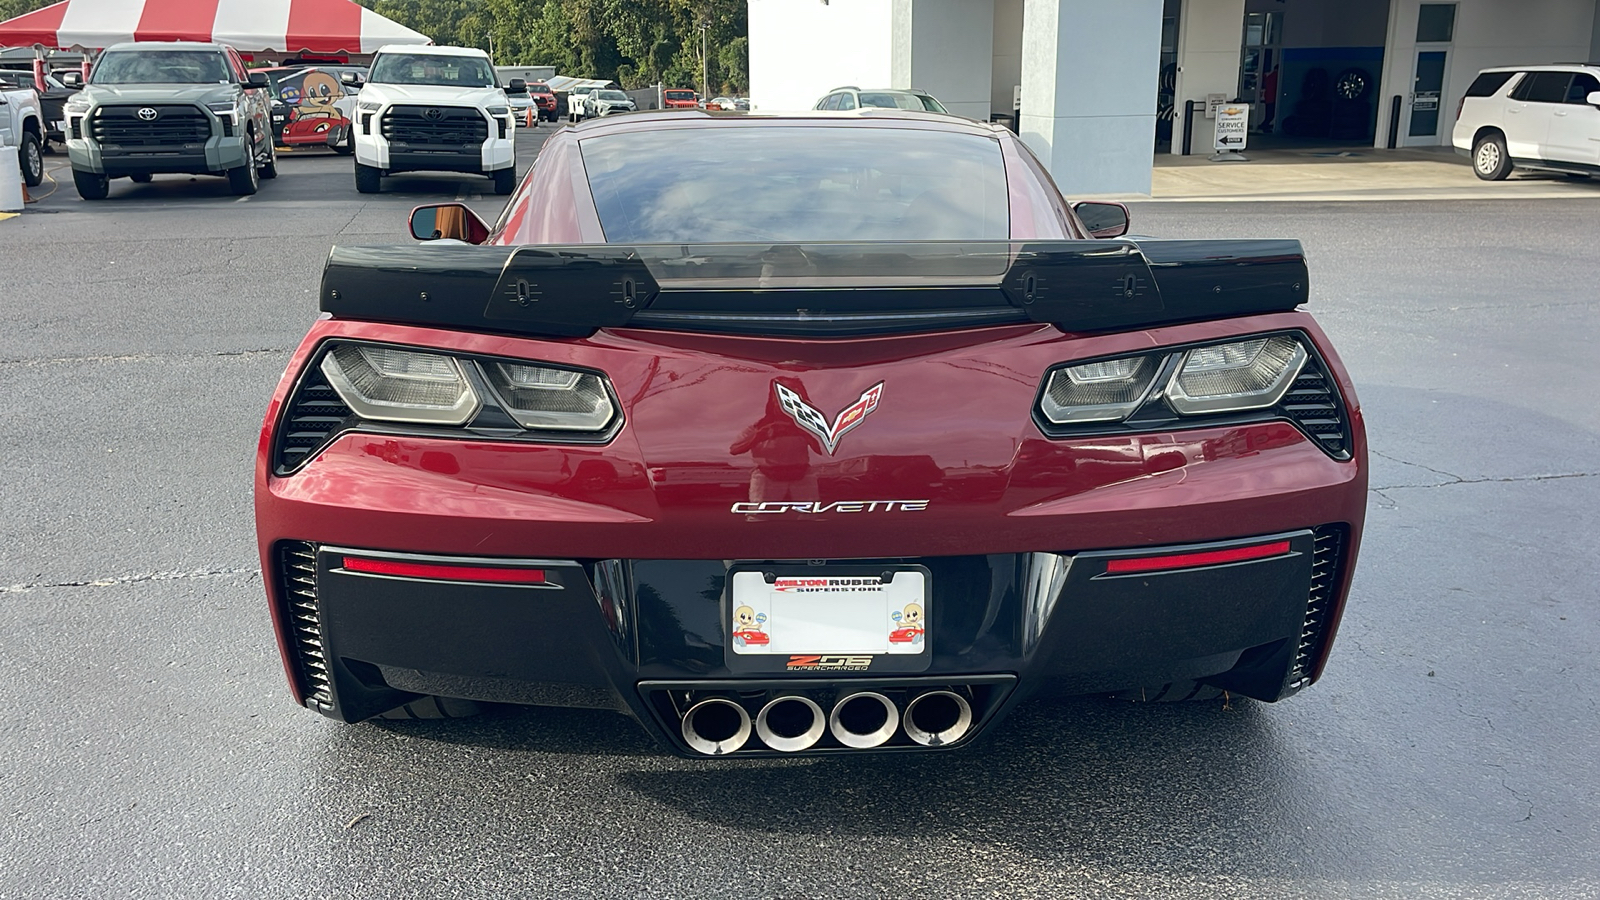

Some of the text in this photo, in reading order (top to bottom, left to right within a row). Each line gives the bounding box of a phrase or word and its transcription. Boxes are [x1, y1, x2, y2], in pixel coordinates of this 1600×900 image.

[731, 500, 930, 513] CORVETTE
[774, 579, 827, 587] MILTON
[786, 655, 874, 666] Z06
